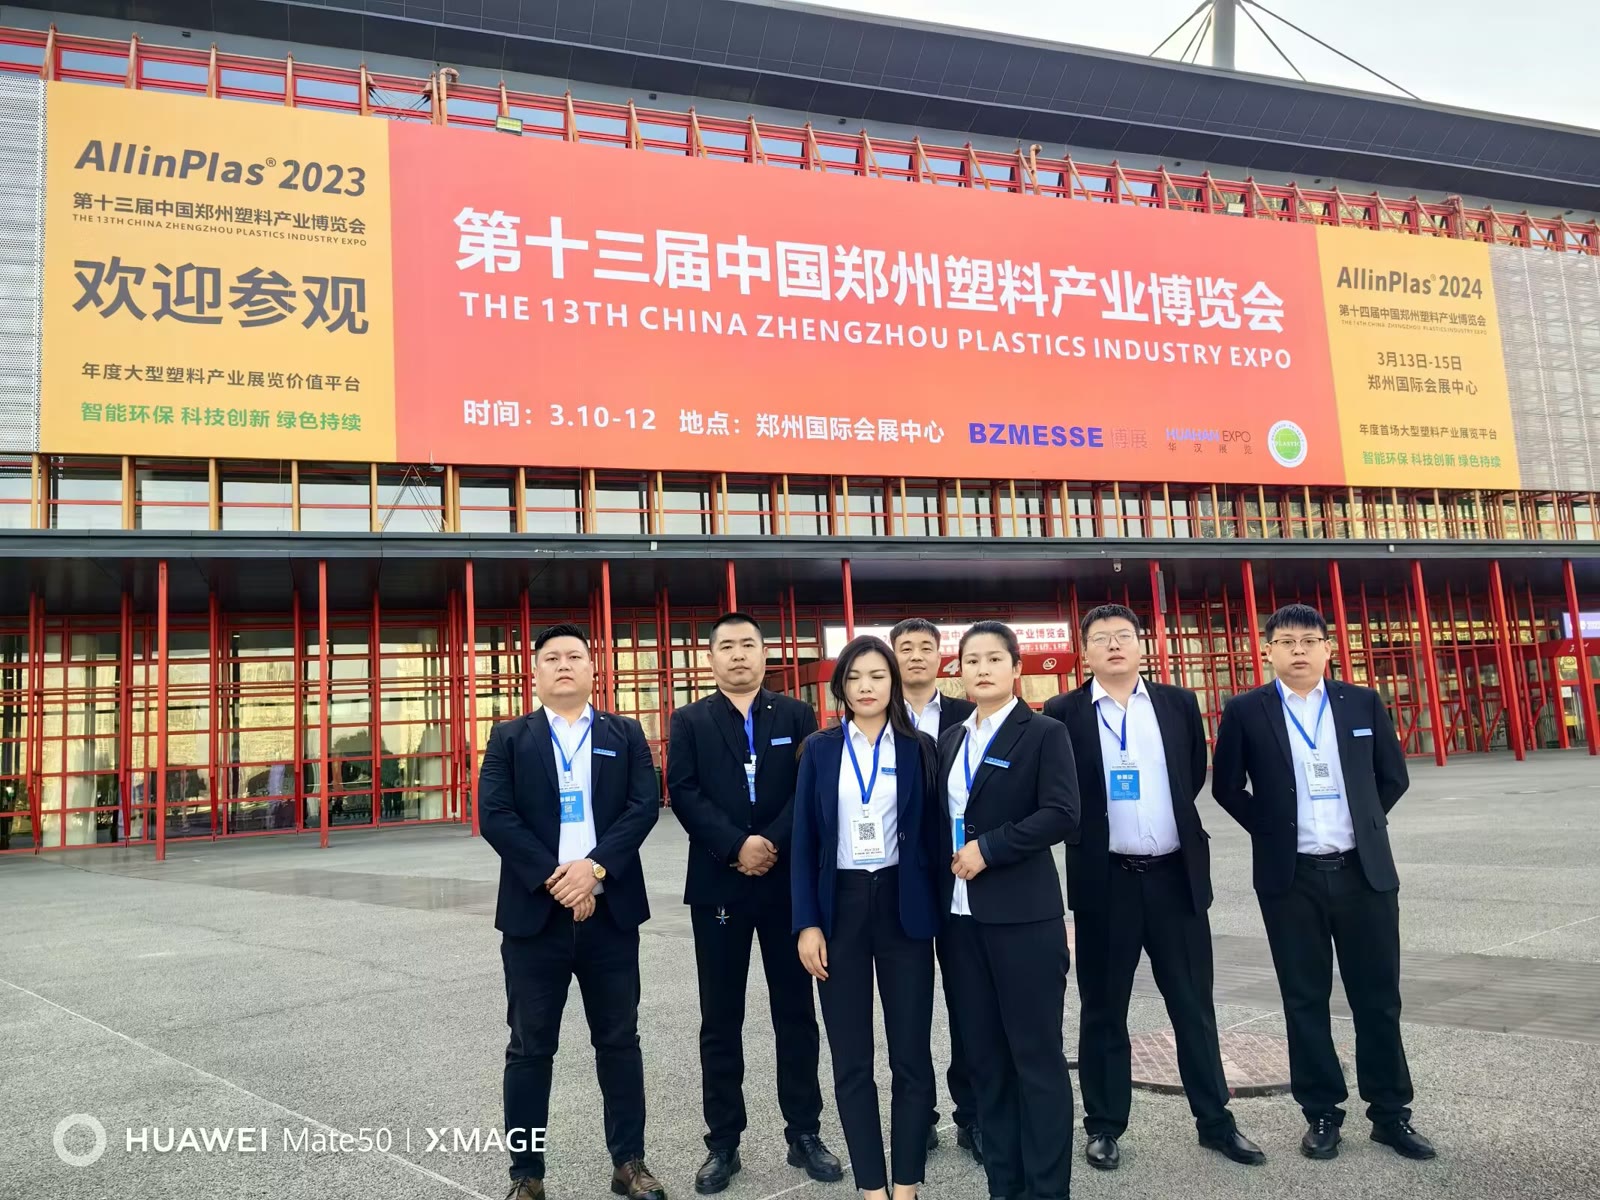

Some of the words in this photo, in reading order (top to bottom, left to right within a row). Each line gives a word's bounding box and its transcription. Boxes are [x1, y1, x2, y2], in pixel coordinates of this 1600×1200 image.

[278, 158, 366, 198] 2023
[72, 191, 367, 236] 第十三届中国郑州塑料产业博览会
[72, 213, 94, 223] THE
[97, 215, 125, 226] 13TH
[127, 217, 163, 229] CHINA
[165, 221, 234, 236] ZHENGZHOU
[236, 227, 286, 240] PLASTICS
[287, 232, 339, 245] INDUSTRY
[341, 236, 368, 247] EXPO
[453, 206, 1285, 335] 第十三届中国郑州塑料产业博览会
[72, 255, 370, 335] 欢迎参观
[1439, 274, 1483, 300] 2024
[1339, 304, 1487, 328] 第十四届中国郑州塑料产业博览会
[459, 291, 530, 321] THE
[541, 297, 629, 328] 13TH
[640, 306, 748, 336] CHINA
[757, 314, 948, 350] ZHENGZHOU
[958, 328, 1086, 358] PLASTICS
[1094, 338, 1222, 366] INDUSTRY
[1230, 347, 1292, 370] EXPO
[1377, 351, 1462, 371] 3月13日-15日
[81, 361, 361, 393] 年度大型塑料产业展览价值平台
[1367, 374, 1478, 396] 郑州国际会展中心
[80, 402, 174, 425] 智能环保
[181, 406, 270, 428] 科技创新
[276, 410, 362, 432] 绿色持续
[968, 422, 1104, 449] BZMESSE
[1166, 426, 1220, 442] HUAHAN
[1222, 430, 1251, 443] EXPO
[1359, 423, 1498, 441] 年度首场大型塑料产业展览平台
[1362, 451, 1409, 466] 智能环保
[1411, 453, 1455, 467] 科技创新
[1458, 454, 1501, 469] 绿色持续
